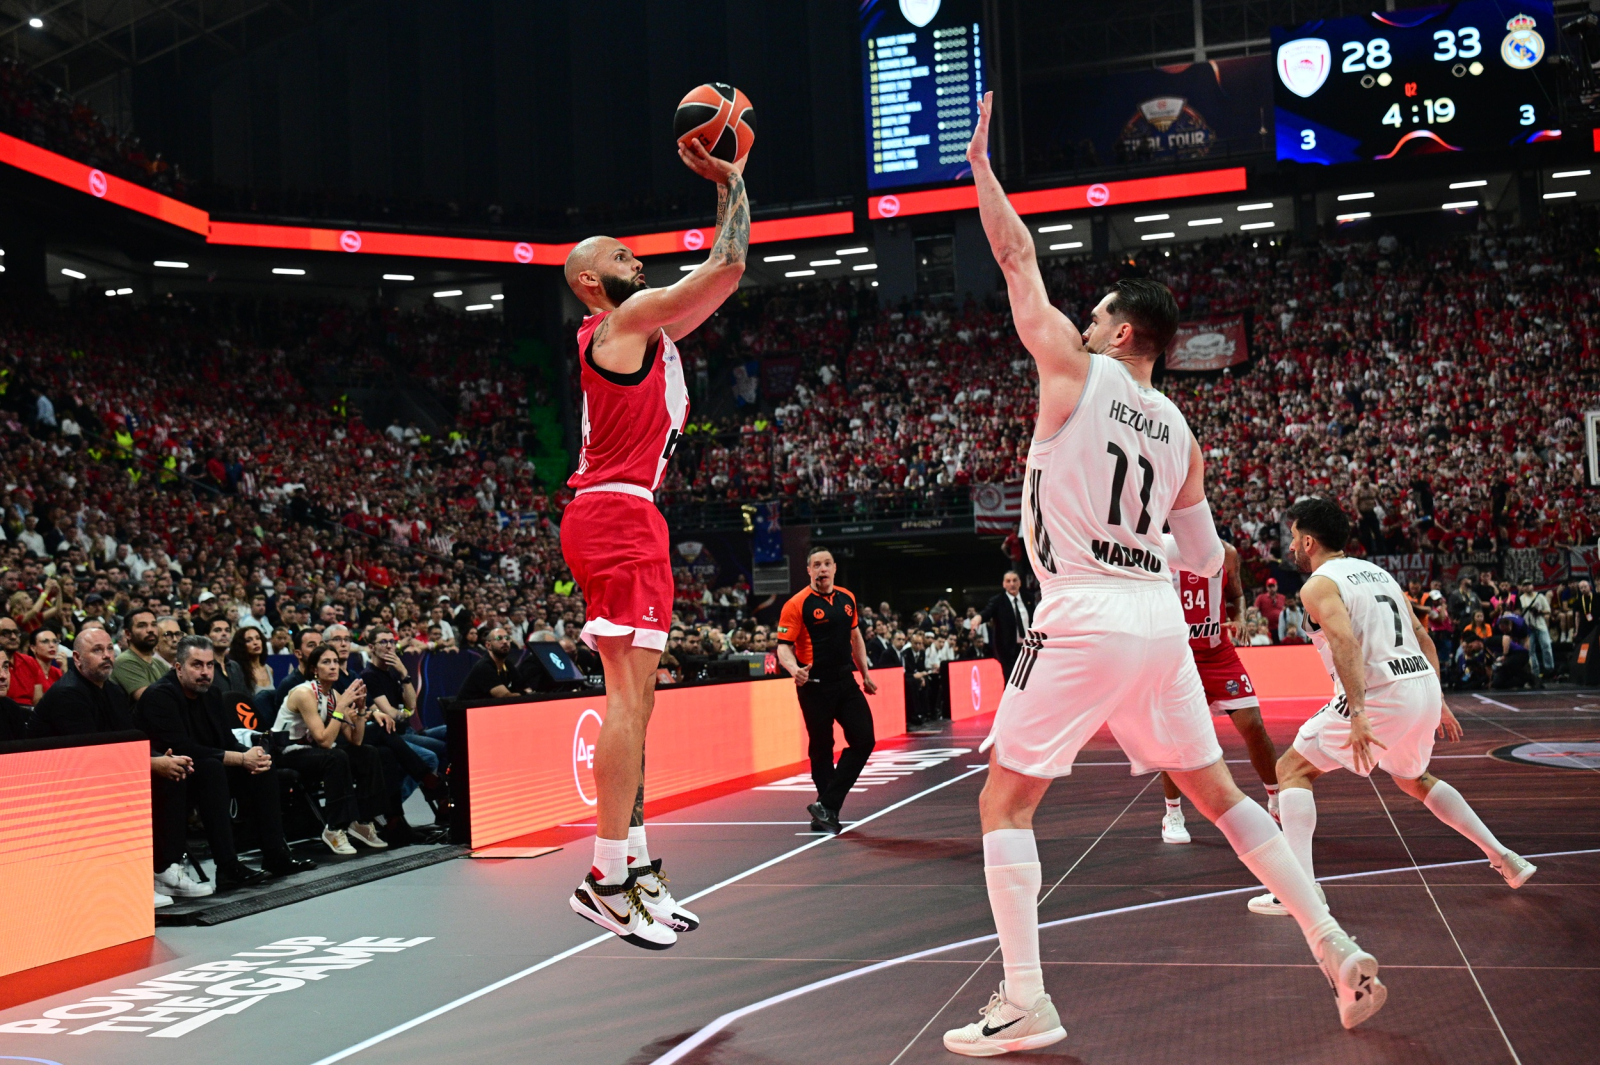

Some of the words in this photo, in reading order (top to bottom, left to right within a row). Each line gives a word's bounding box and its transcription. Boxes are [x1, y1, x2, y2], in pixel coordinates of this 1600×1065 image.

[1341, 38, 1392, 73] 28
[1433, 26, 1482, 61] 33
[1404, 82, 1417, 97] Q2
[1381, 97, 1455, 128] 4:19
[1519, 104, 1535, 125] 3
[1168, 131, 1205, 149] FOUR
[1300, 129, 1316, 150] 3
[1109, 399, 1169, 444] HEZONJA
[1106, 441, 1154, 535] 11
[1183, 588, 1206, 610] 34
[1189, 616, 1221, 638] win
[1374, 594, 1404, 648] 7
[1387, 653, 1429, 677] MADRID
[0, 960, 281, 1035] POWER
[231, 936, 337, 958] UP
[66, 996, 239, 1035] THE
[205, 936, 436, 996] GAME
